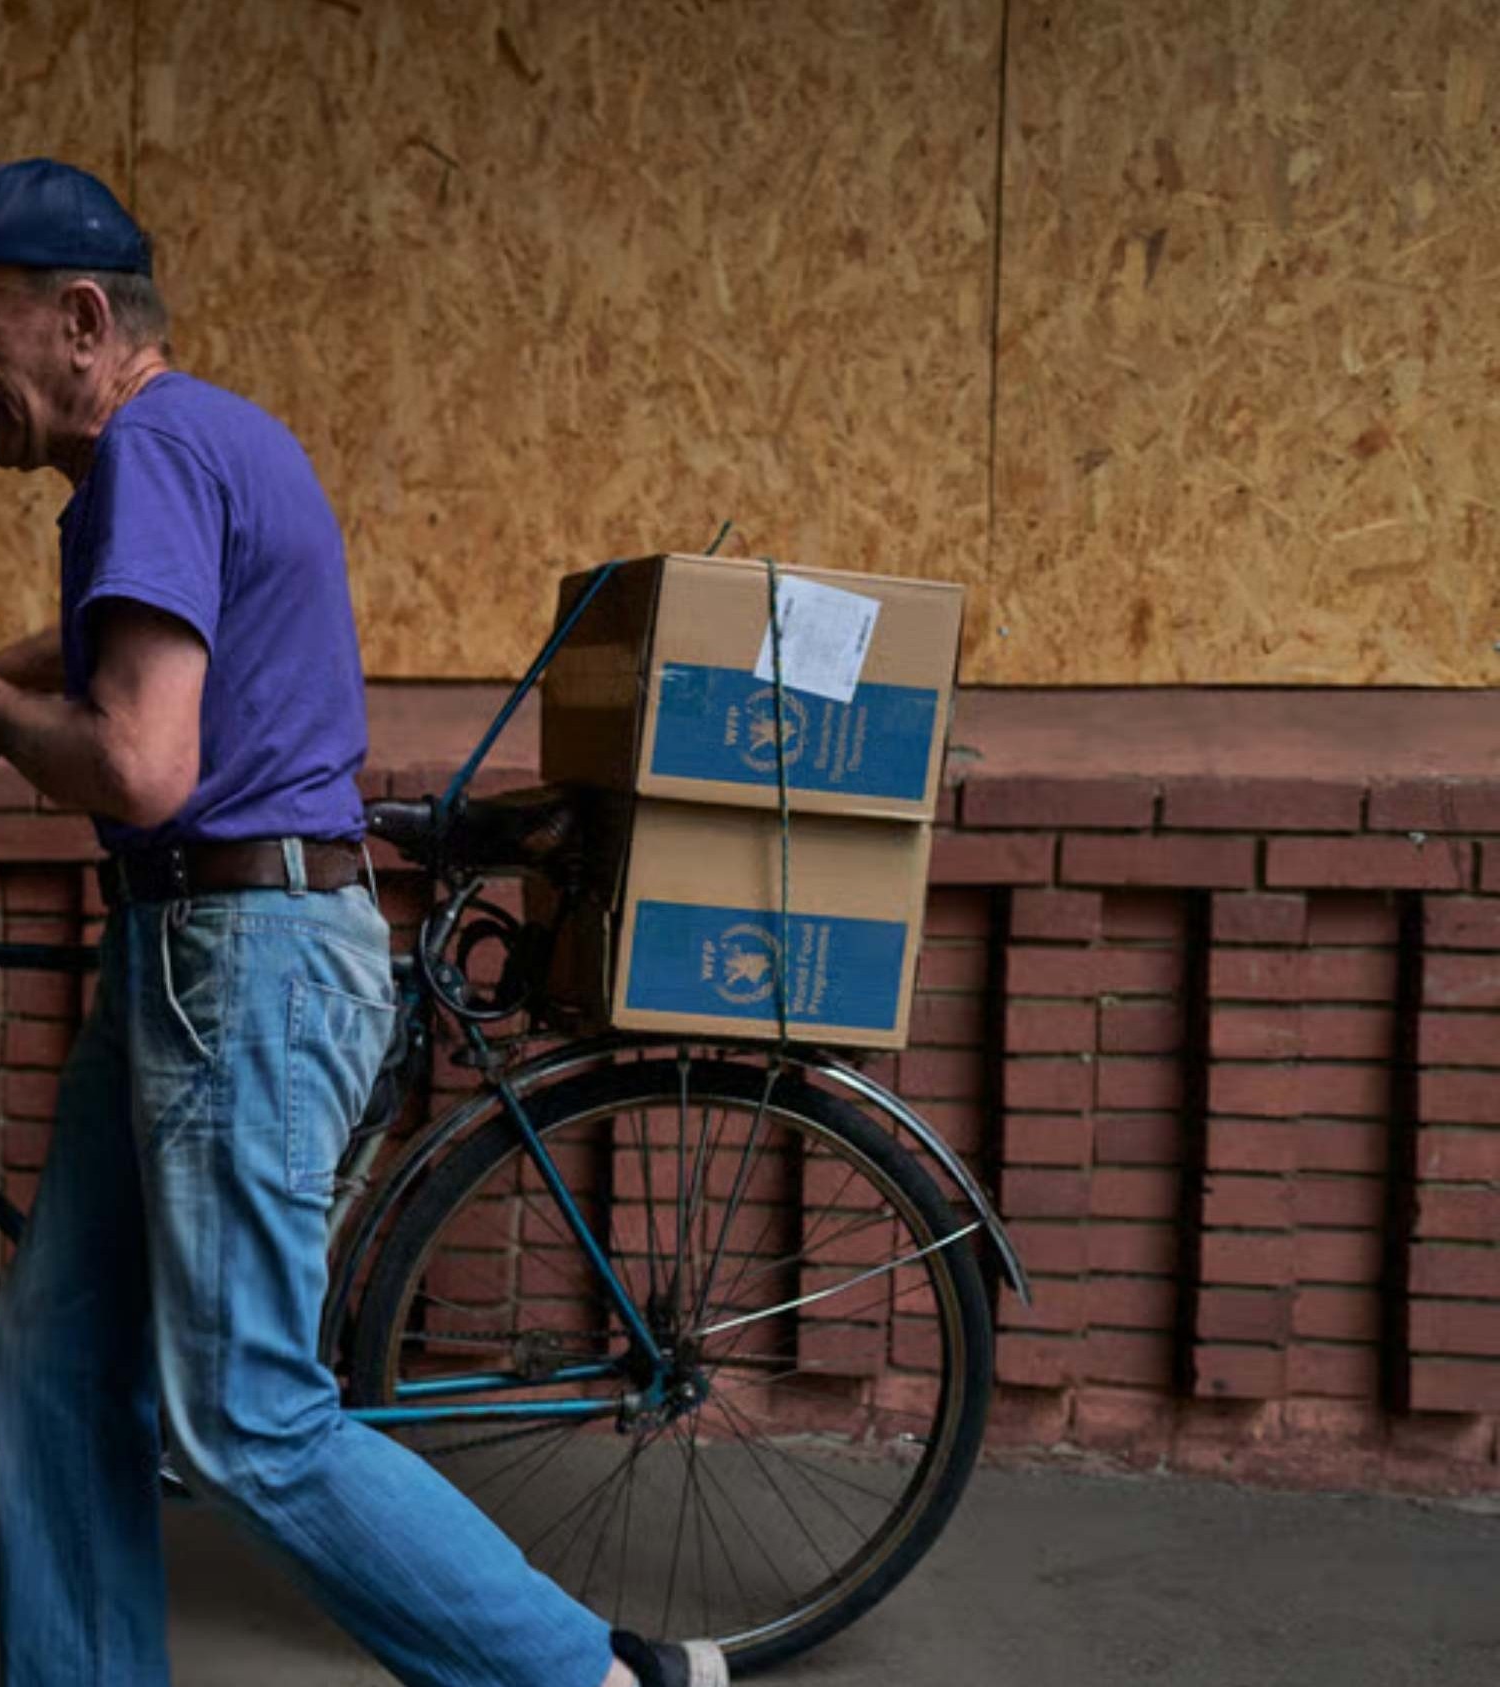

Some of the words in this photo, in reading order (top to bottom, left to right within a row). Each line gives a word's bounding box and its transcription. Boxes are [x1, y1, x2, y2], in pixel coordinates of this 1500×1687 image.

[725, 705, 739, 745] WFP
[702, 940, 716, 980] WFP
[798, 924, 813, 962] Food
